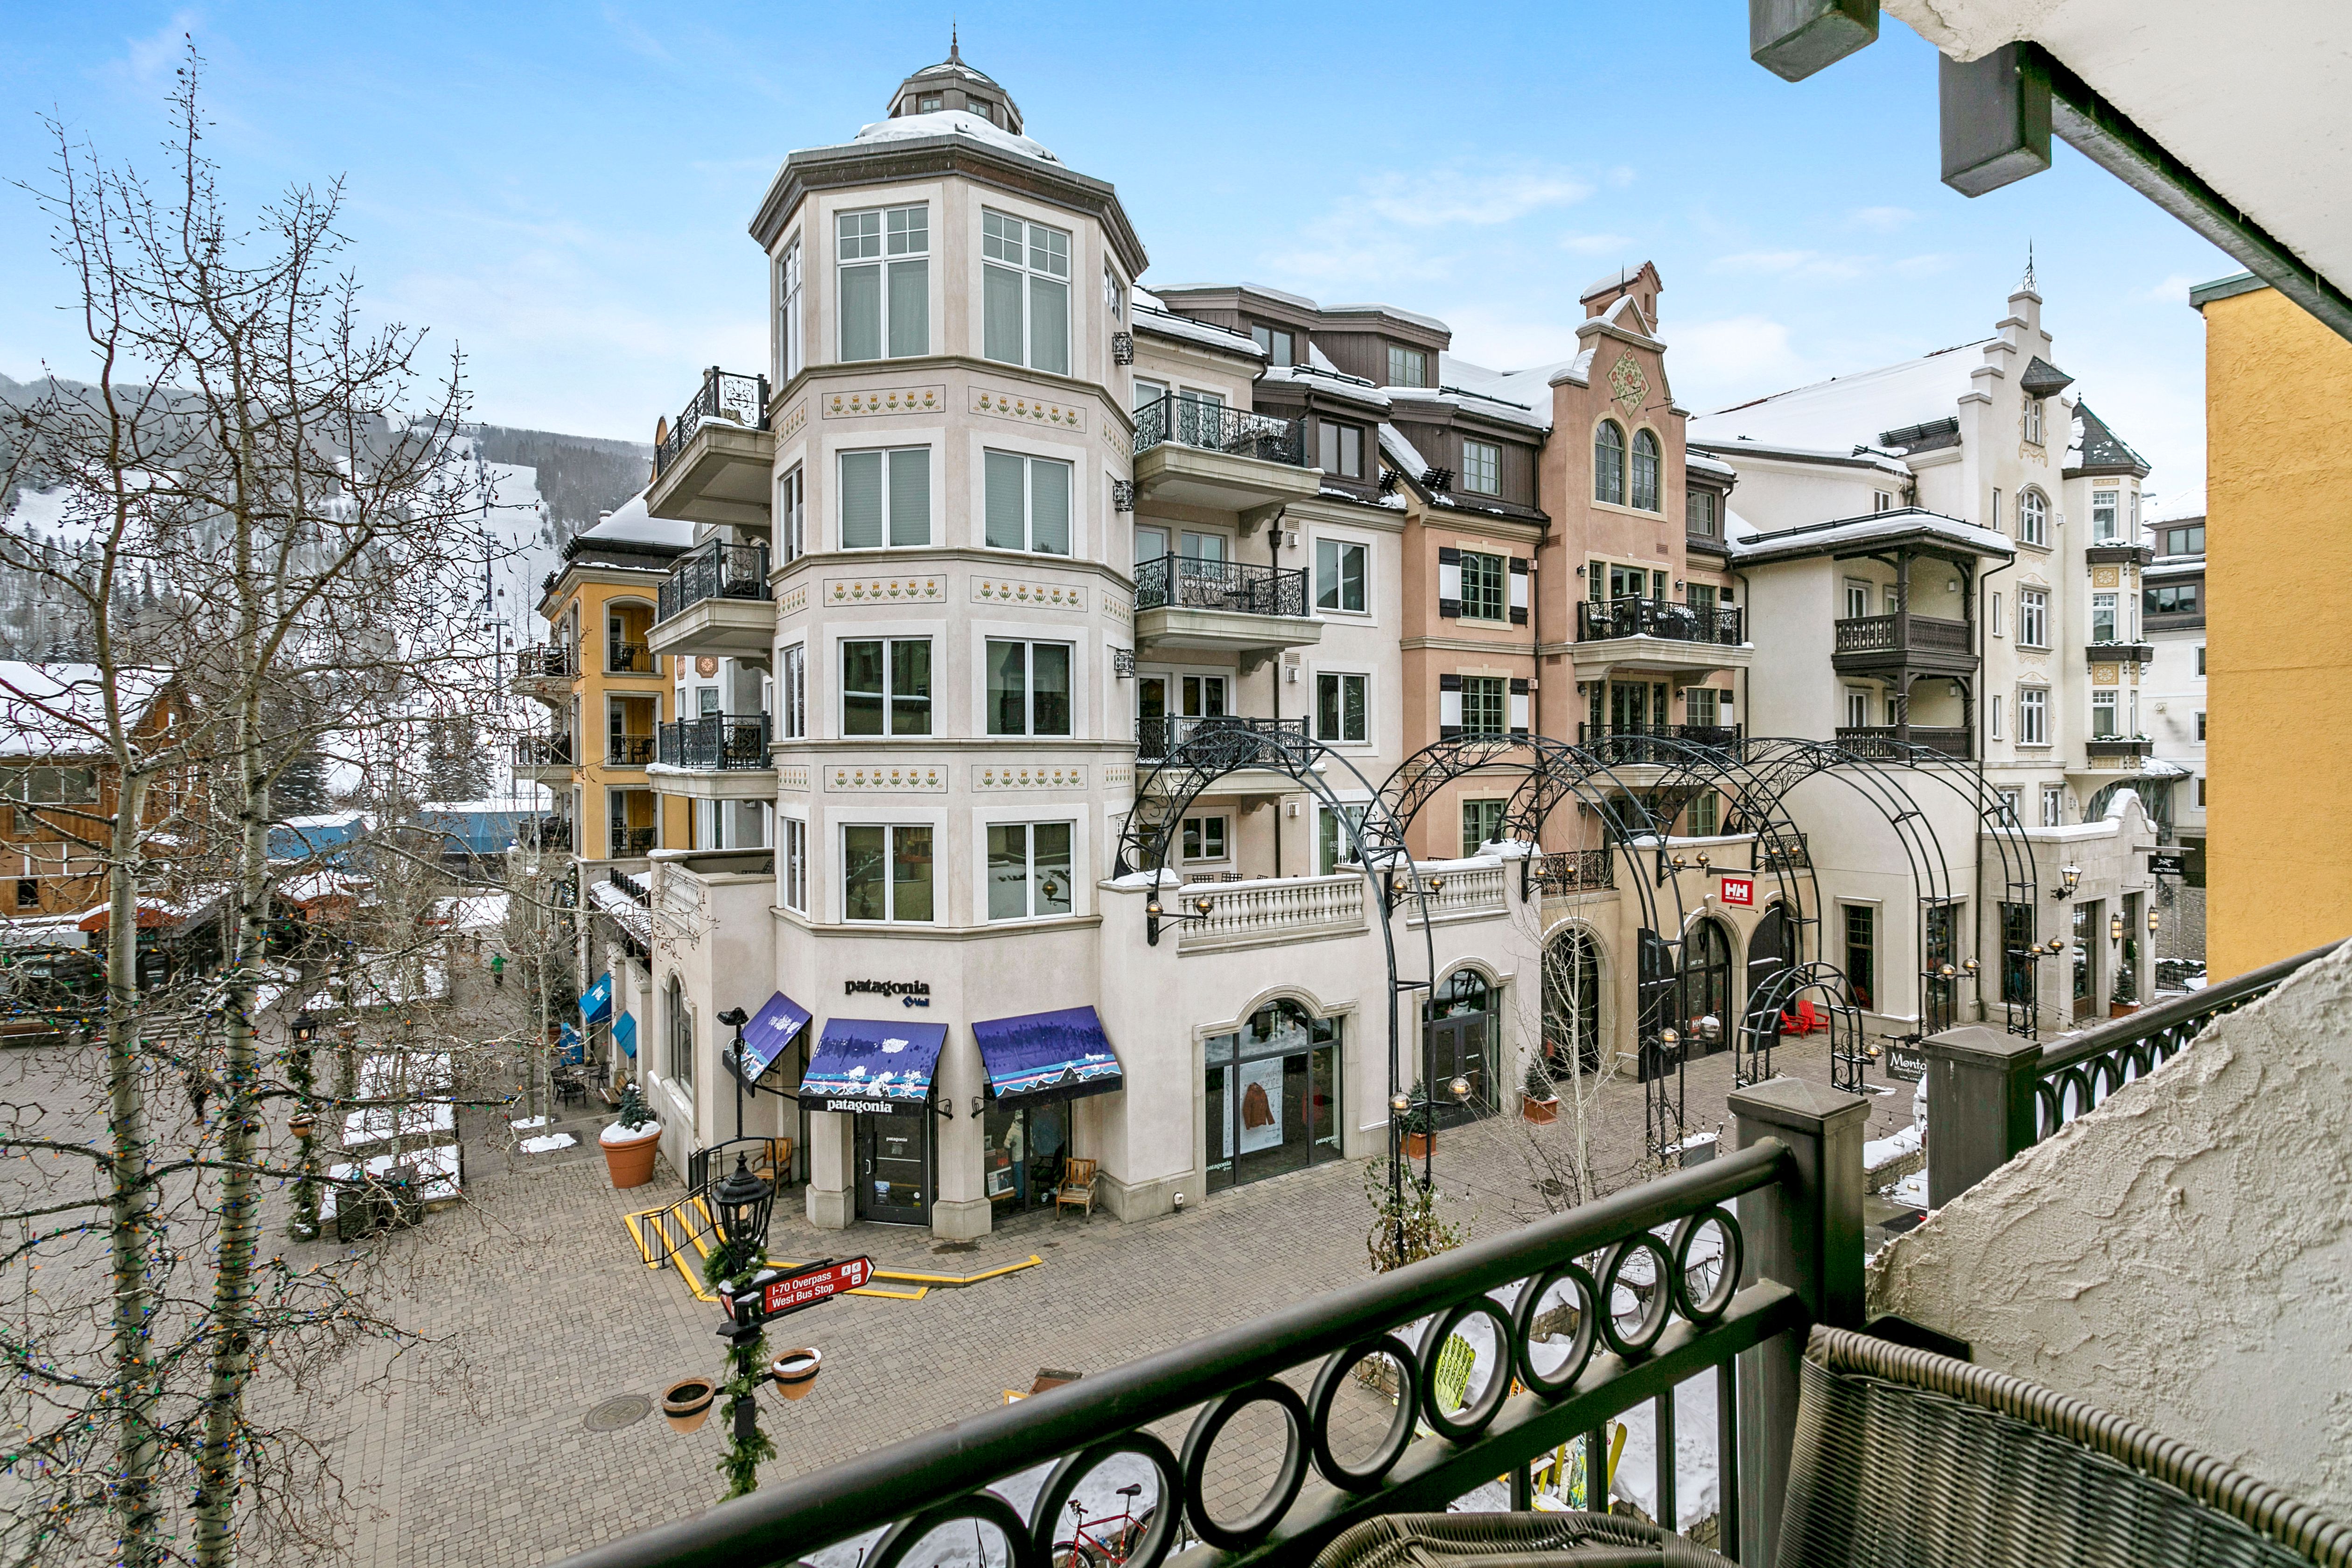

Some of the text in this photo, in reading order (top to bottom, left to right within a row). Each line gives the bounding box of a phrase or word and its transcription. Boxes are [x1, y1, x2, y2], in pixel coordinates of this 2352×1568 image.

[1725, 882, 1748, 898] HH
[845, 979, 930, 997] patagonia
[913, 998, 930, 1007] Vail
[1894, 1066, 1921, 1074] Seafood
[826, 1099, 893, 1113] patagonia
[772, 1272, 832, 1295] I-70 Overpass
[772, 1284, 834, 1308] West Bus Stop
[1437, 1339, 1450, 1386] FISCHER
[1443, 1338, 1457, 1386] FISCHER
[1449, 1342, 1464, 1388] FISCHER
[1453, 1347, 1469, 1394] FISCHER
[1456, 1357, 1473, 1404] FISCHER
